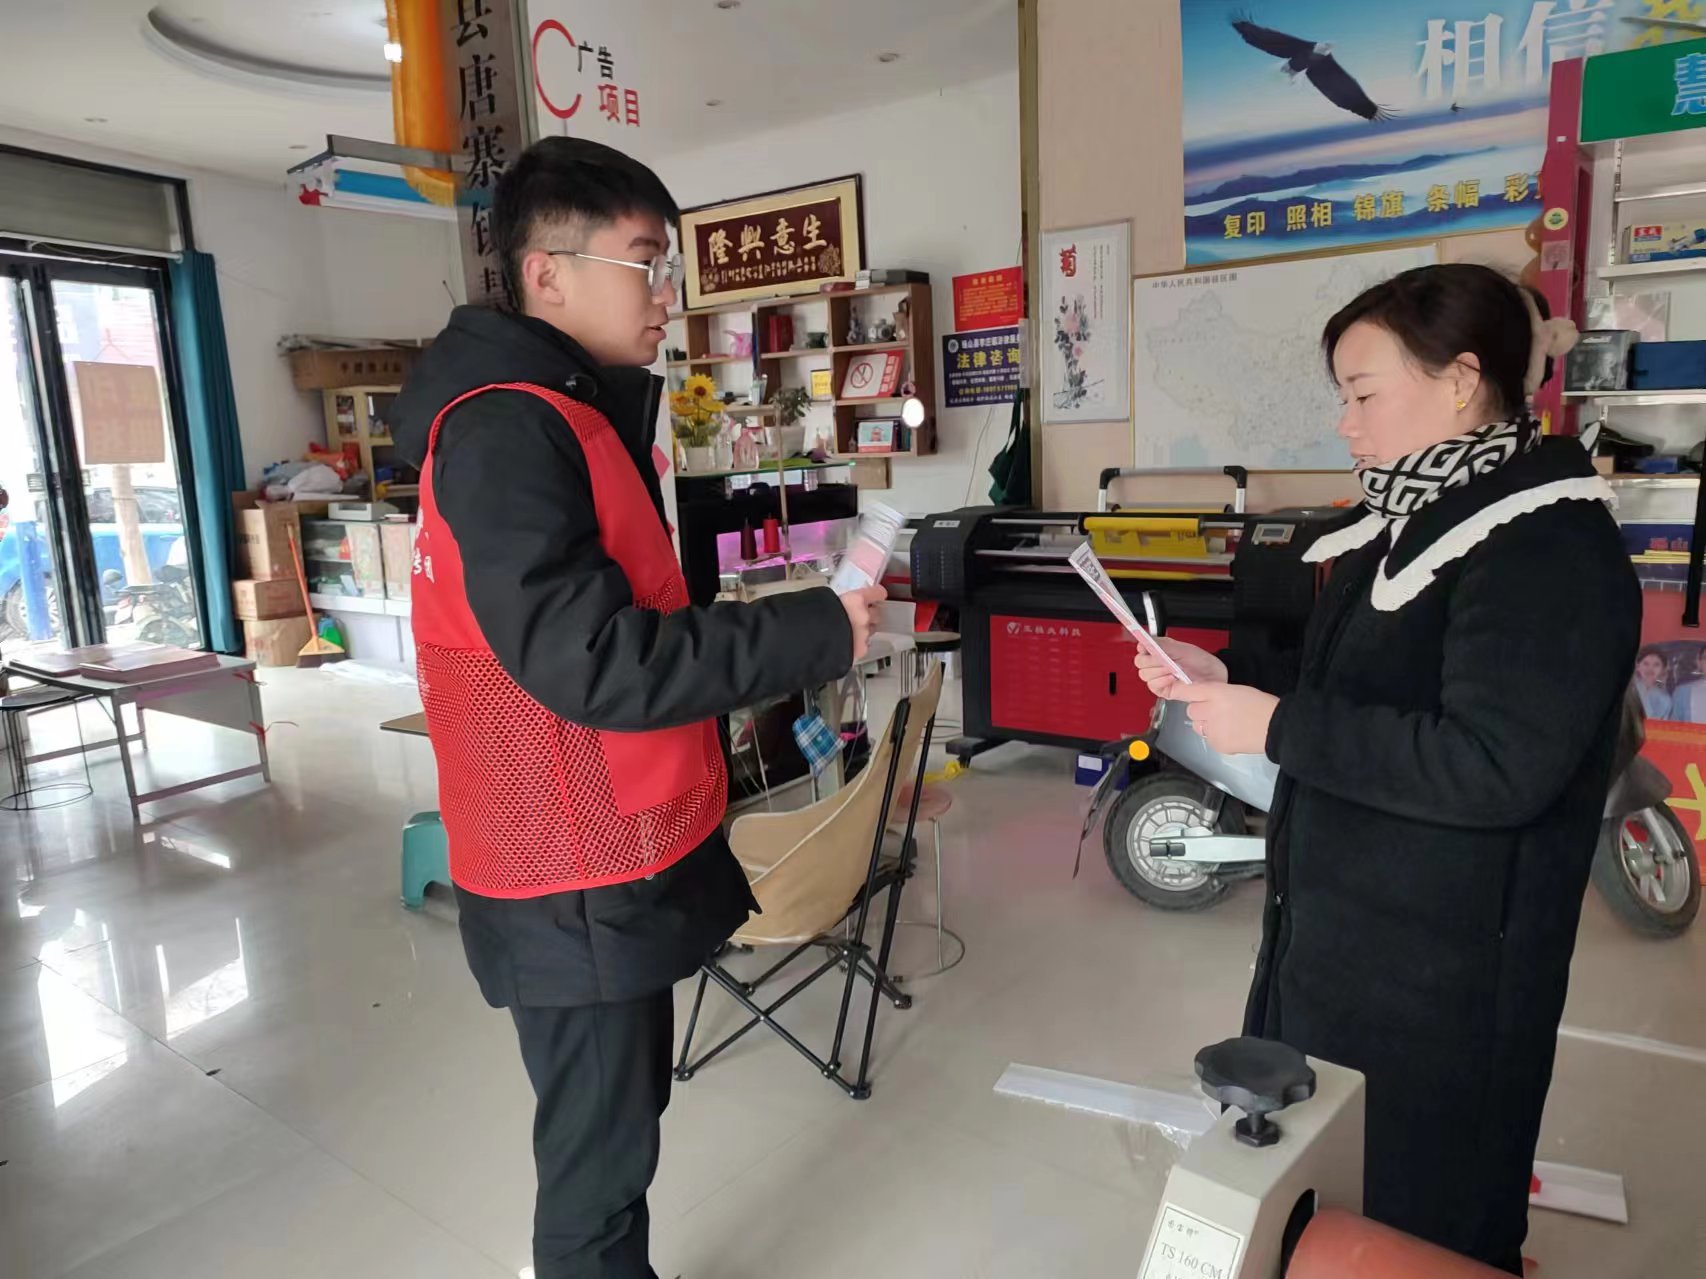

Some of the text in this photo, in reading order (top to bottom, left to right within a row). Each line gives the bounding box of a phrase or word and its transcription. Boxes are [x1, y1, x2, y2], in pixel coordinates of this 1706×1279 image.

[576, 41, 615, 80] 广告
[597, 83, 640, 127] 项目
[1223, 209, 1266, 240] 复印
[1285, 201, 1332, 231] 照相
[1353, 190, 1405, 222] 锦旗
[1426, 177, 1481, 213] 条幅
[957, 348, 1021, 369] 法律咨询
[1161, 1242, 1177, 1260] TS
[1179, 1251, 1199, 1270] 160
